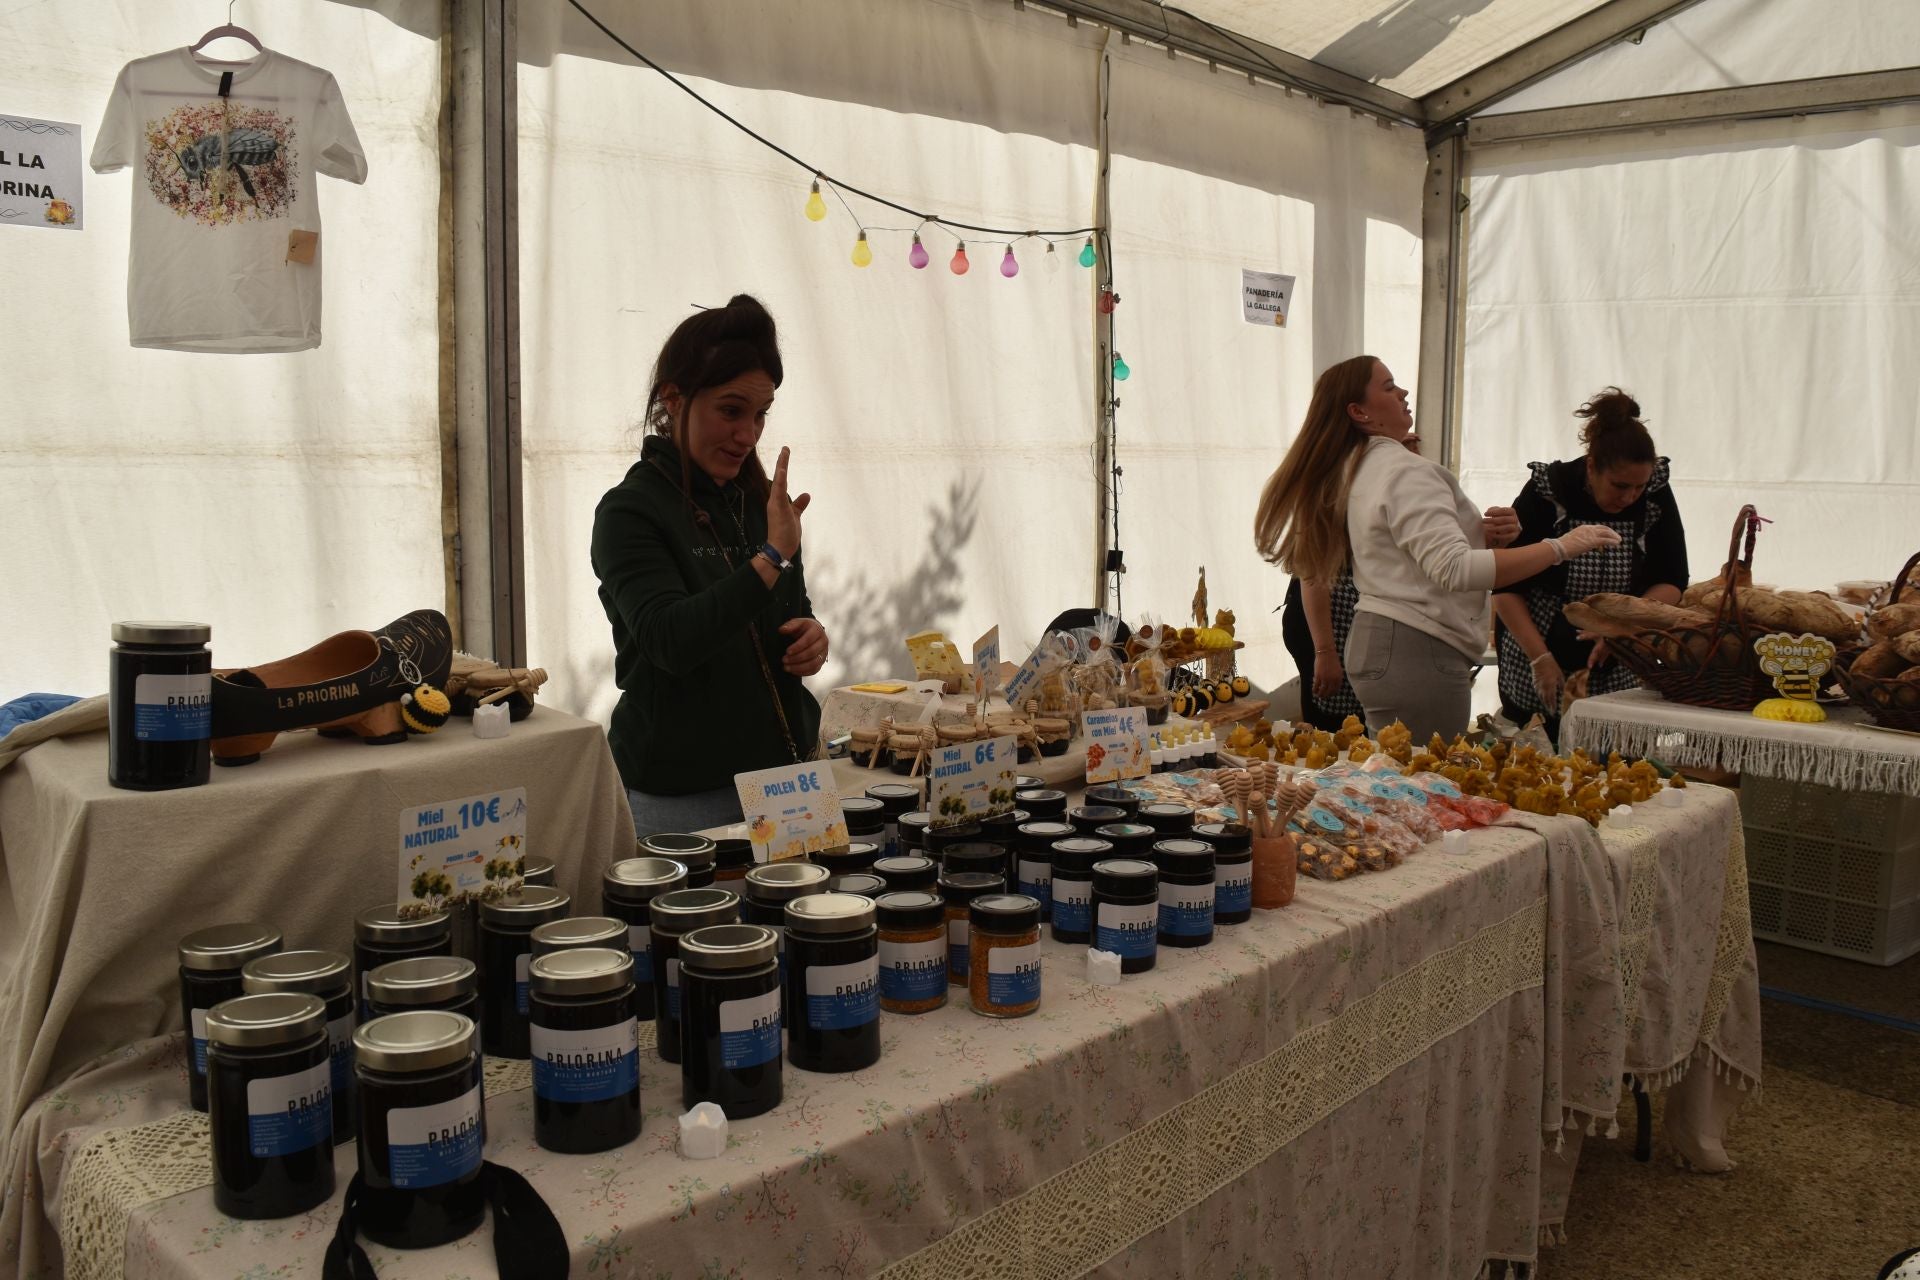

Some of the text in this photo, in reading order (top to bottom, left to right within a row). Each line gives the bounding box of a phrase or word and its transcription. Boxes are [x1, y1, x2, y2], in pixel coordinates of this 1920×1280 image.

[18, 152, 45, 170] LA
[0, 180, 55, 200] RINA
[1246, 301, 1281, 313] LA GALLEGA
[1773, 645, 1818, 658] HONEY
[1005, 668, 1027, 694] Detalles
[277, 681, 360, 709] La PRIORINA
[1086, 714, 1118, 726] Caramelos
[1119, 716, 1134, 735] 4€
[1091, 726, 1117, 737] con Miel
[943, 748, 961, 763] Miel
[974, 741, 995, 765] 6€
[934, 761, 972, 779] NATURAL
[763, 771, 821, 798] POLEN 8€
[417, 808, 443, 827] Miel
[458, 797, 500, 830] 10€
[404, 825, 459, 849] NATURAL
[546, 1047, 624, 1071] PRIORINA
